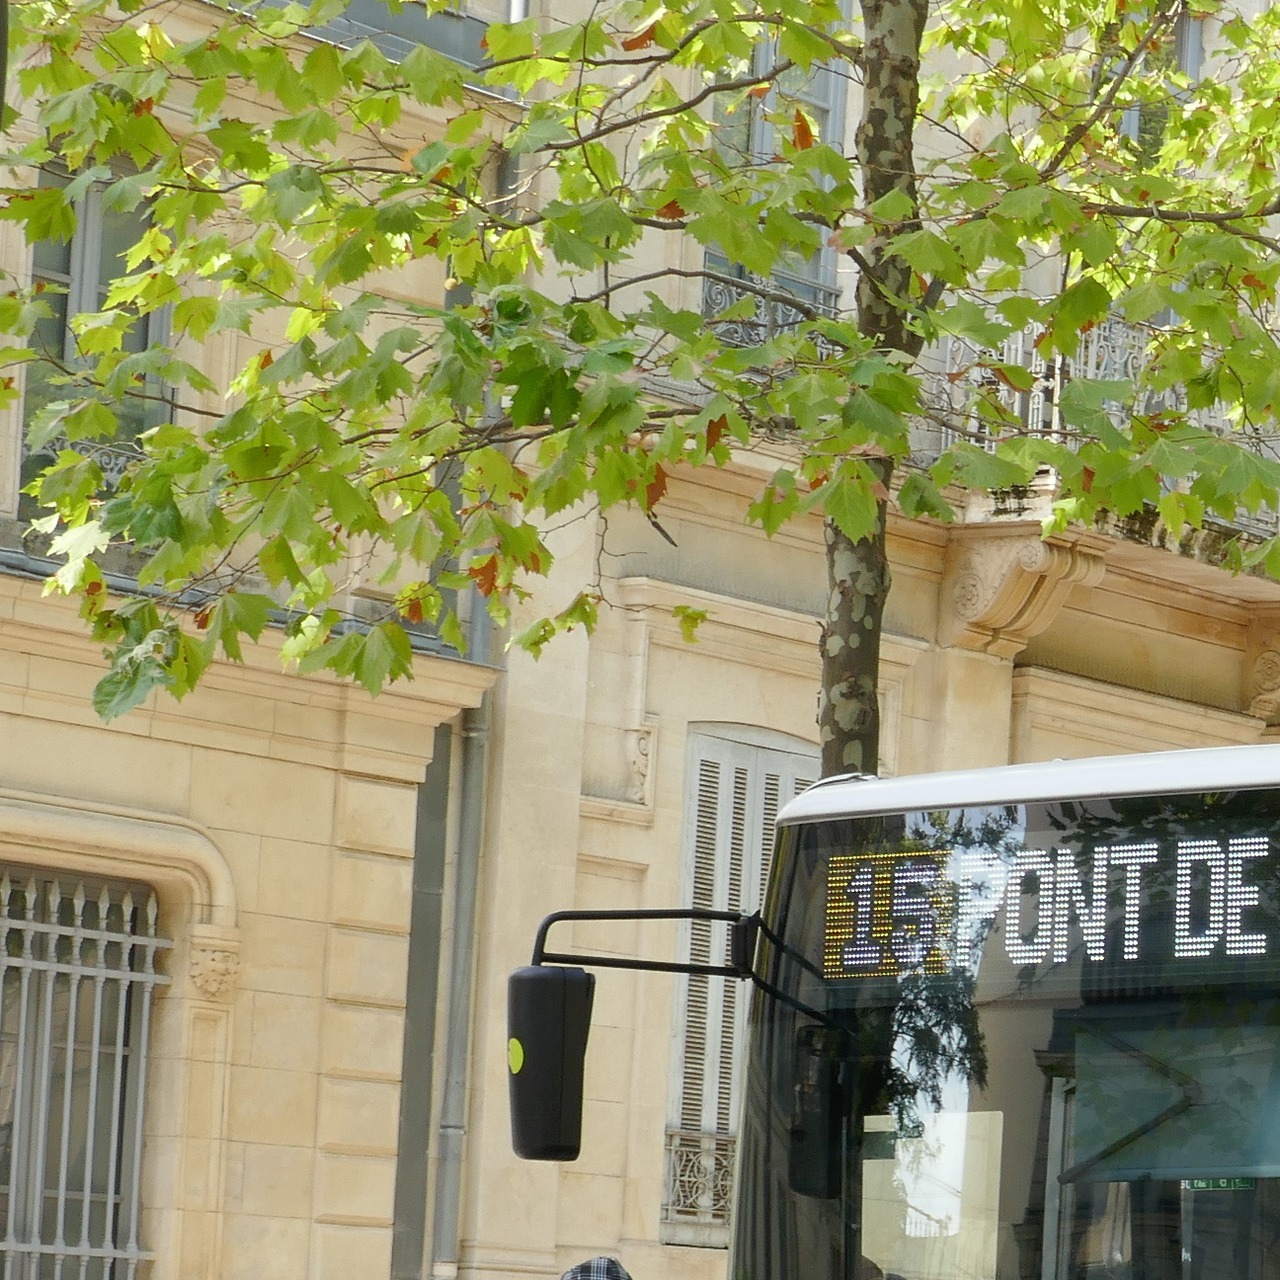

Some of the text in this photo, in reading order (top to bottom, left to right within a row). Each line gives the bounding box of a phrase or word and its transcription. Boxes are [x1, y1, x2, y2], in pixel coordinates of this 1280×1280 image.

[843, 864, 937, 965] 15
[955, 840, 1158, 967] PONT
[1172, 836, 1269, 958] DE
